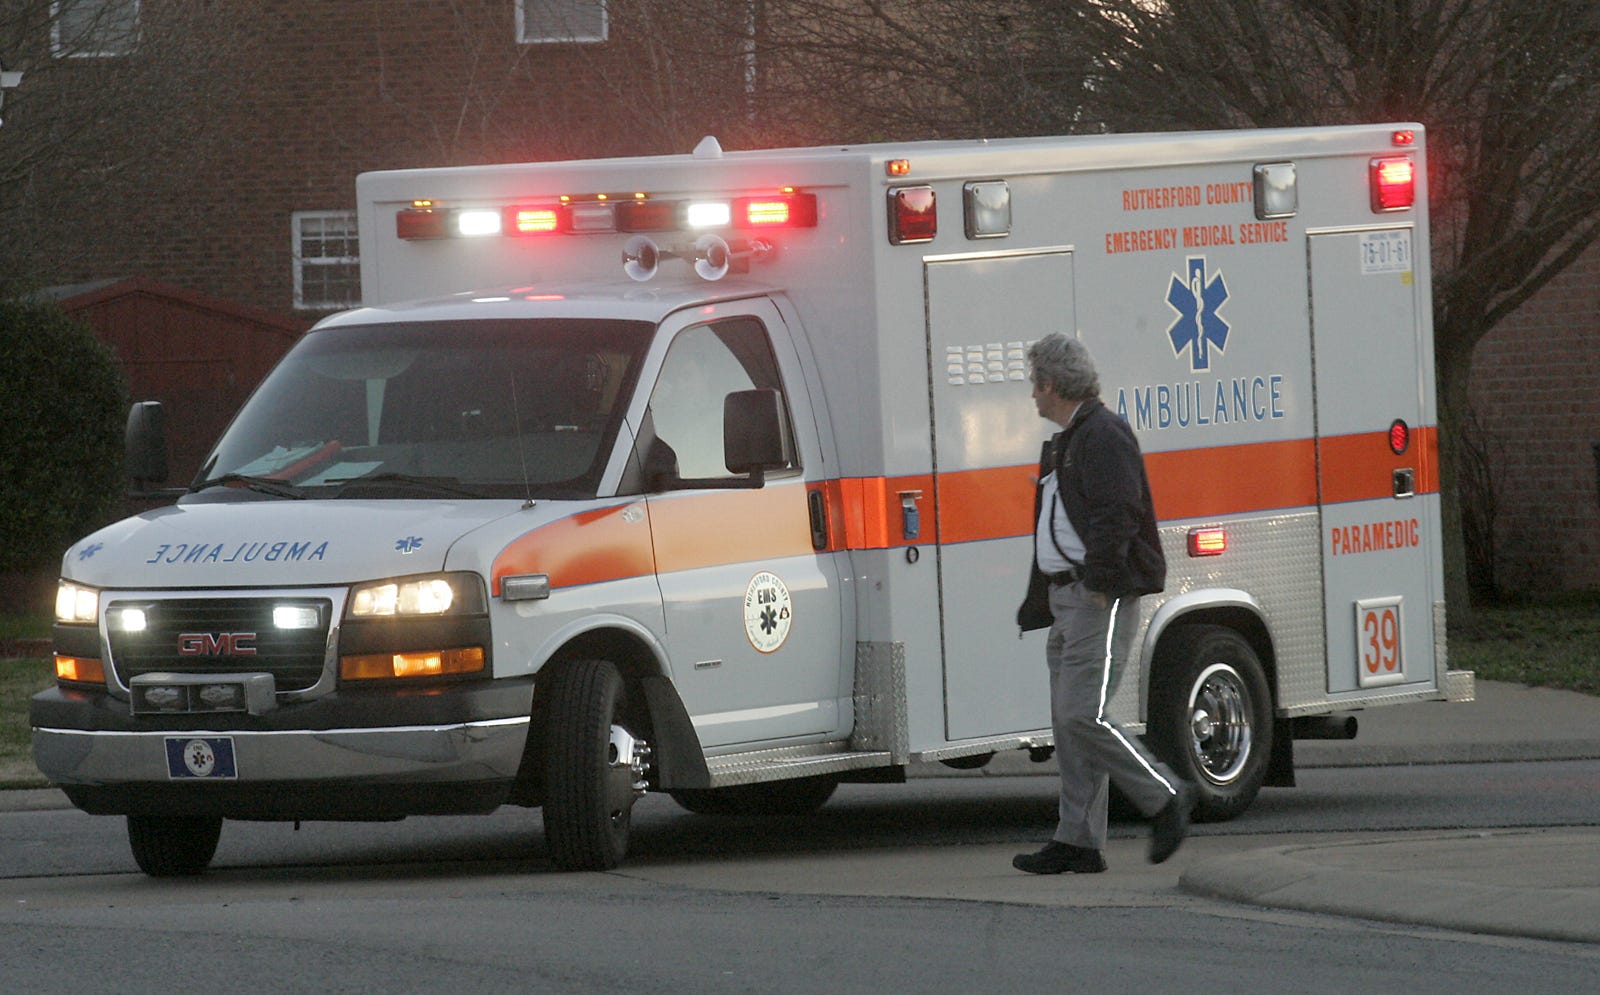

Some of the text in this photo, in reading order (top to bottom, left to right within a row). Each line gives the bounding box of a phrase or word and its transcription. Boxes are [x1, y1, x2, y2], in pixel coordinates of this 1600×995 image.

[1122, 185, 1201, 211] RUTHERFORD
[1105, 221, 1289, 254] EMERGENCY MEDICAL SERVICE
[1116, 374, 1285, 432] AMBULANCE
[1331, 518, 1420, 556] PARAMEDIC
[757, 587, 777, 605] EMS
[772, 576, 788, 602] COUNTY
[177, 632, 257, 656] GMC
[1364, 609, 1398, 674] 39
